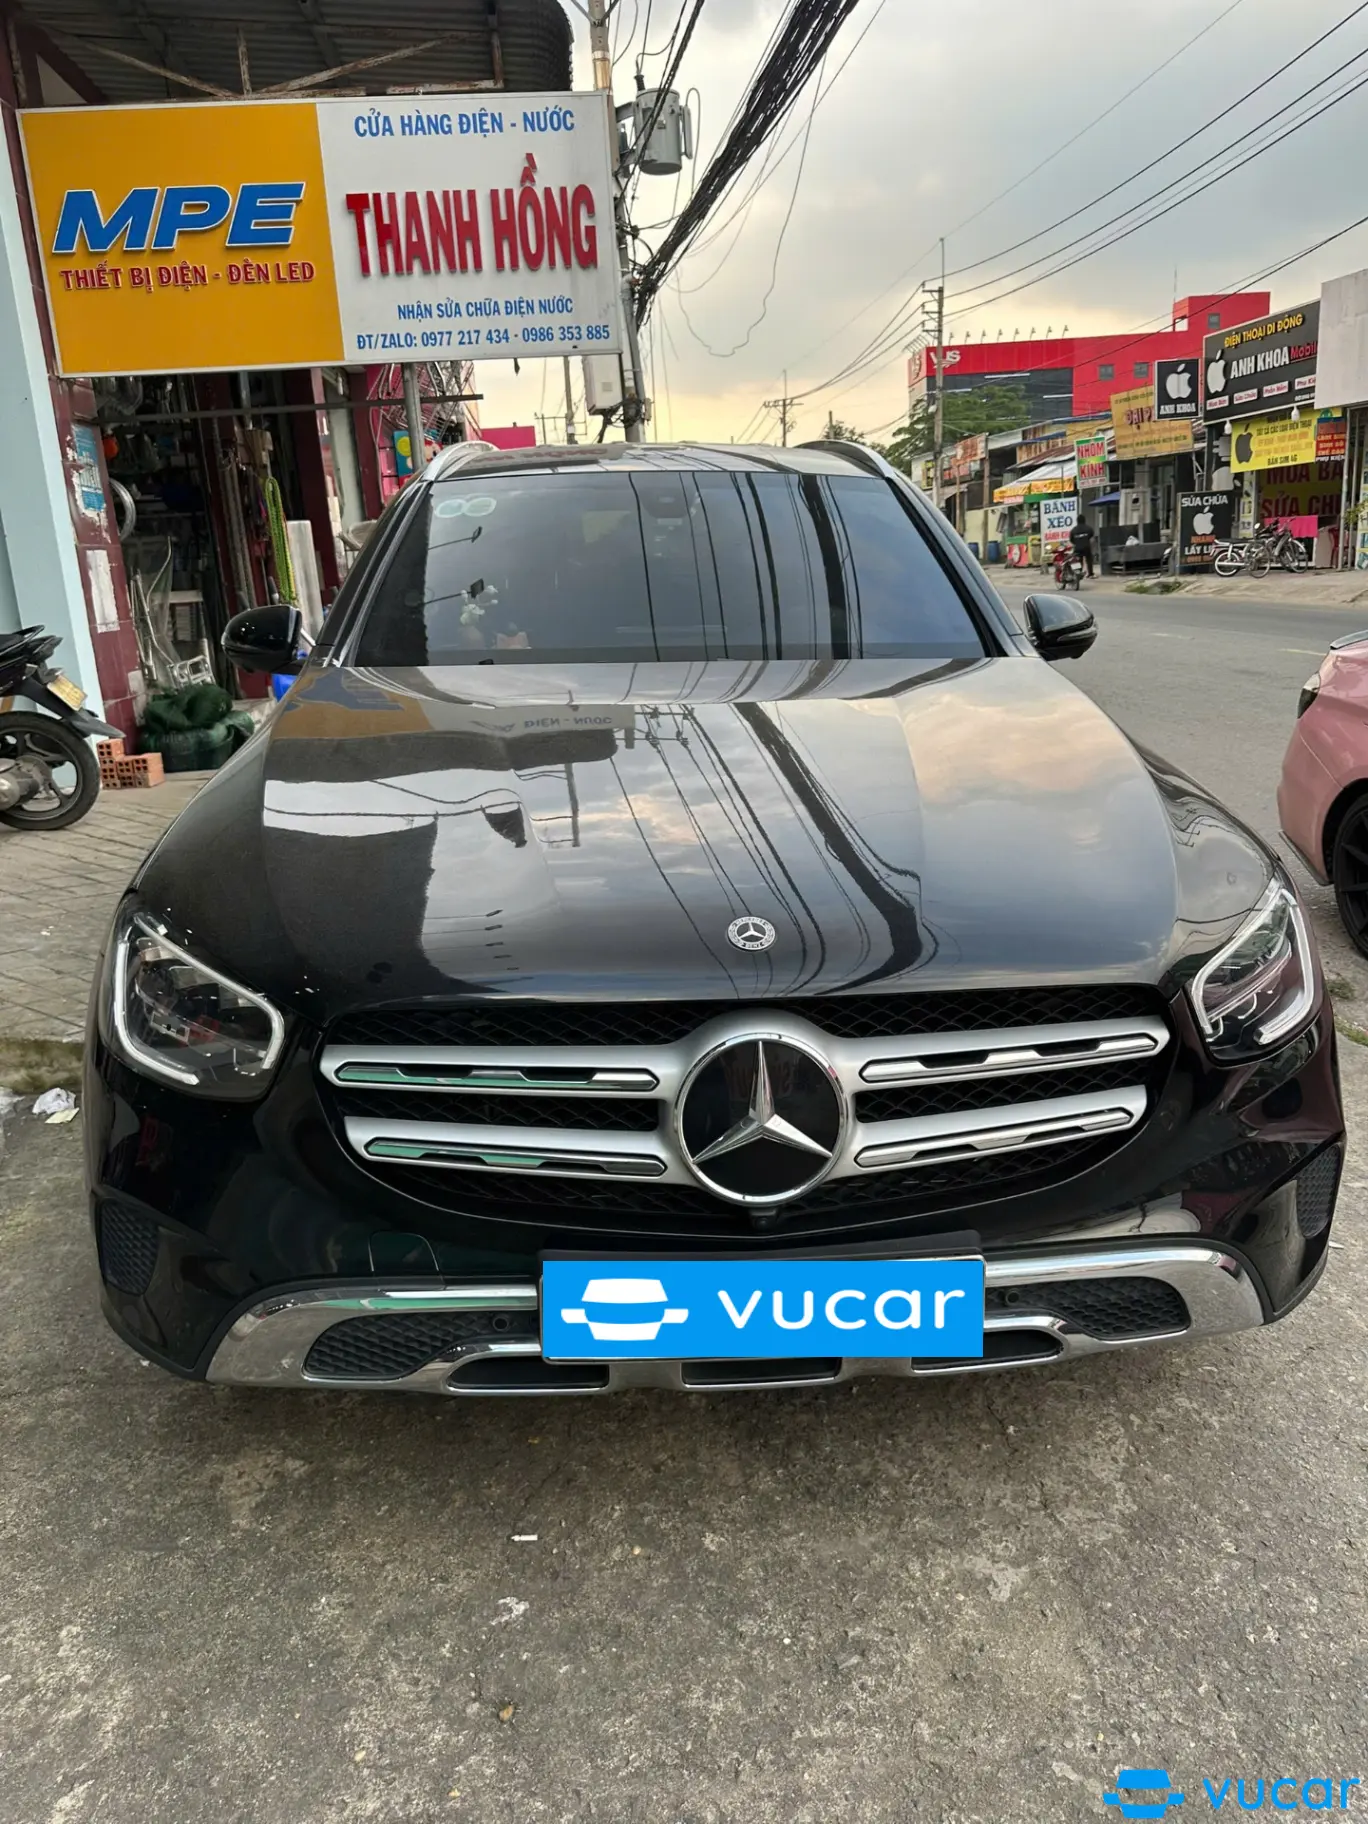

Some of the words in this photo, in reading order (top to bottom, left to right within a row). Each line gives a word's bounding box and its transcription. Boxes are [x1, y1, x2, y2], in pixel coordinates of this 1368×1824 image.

[354, 107, 394, 138] CỬA
[400, 109, 453, 136] HÀNG
[458, 107, 504, 138] ĐIỆN
[523, 104, 575, 133] NƯỚC
[52, 181, 305, 253] MPE
[346, 188, 483, 277] THANH
[490, 152, 598, 272] HỒNG
[60, 259, 122, 291] THIẾT
[130, 267, 154, 293] BỊ
[158, 260, 208, 292] ĐIỆN
[228, 257, 271, 285] ĐÈN
[275, 261, 315, 283] LED
[397, 300, 433, 323] NHẬN
[437, 296, 462, 318] SỬA
[466, 297, 501, 318] CHỮA
[504, 296, 535, 317] ĐIỆN
[539, 294, 574, 314] NƯỚC
[357, 331, 417, 349] ĐT/ZALO:
[421, 331, 452, 347] 0977
[457, 329, 480, 345] 217
[486, 328, 510, 344] 434
[522, 327, 554, 343] 0986
[559, 326, 582, 341] 353
[586, 325, 610, 340] 885
[1224, 332, 1241, 349] ĐIỆN
[1242, 325, 1266, 341] THOẠI
[1267, 322, 1276, 334] DI
[1276, 313, 1303, 333] ĐỘNG
[1230, 355, 1255, 379] ANH
[1256, 346, 1290, 373] KHOA
[1290, 342, 1317, 360] Mobil
[1160, 404, 1175, 415] ANH
[1176, 403, 1196, 413] KHOA
[1077, 442, 1104, 458] NHÔM
[1080, 461, 1105, 478] KÍNH
